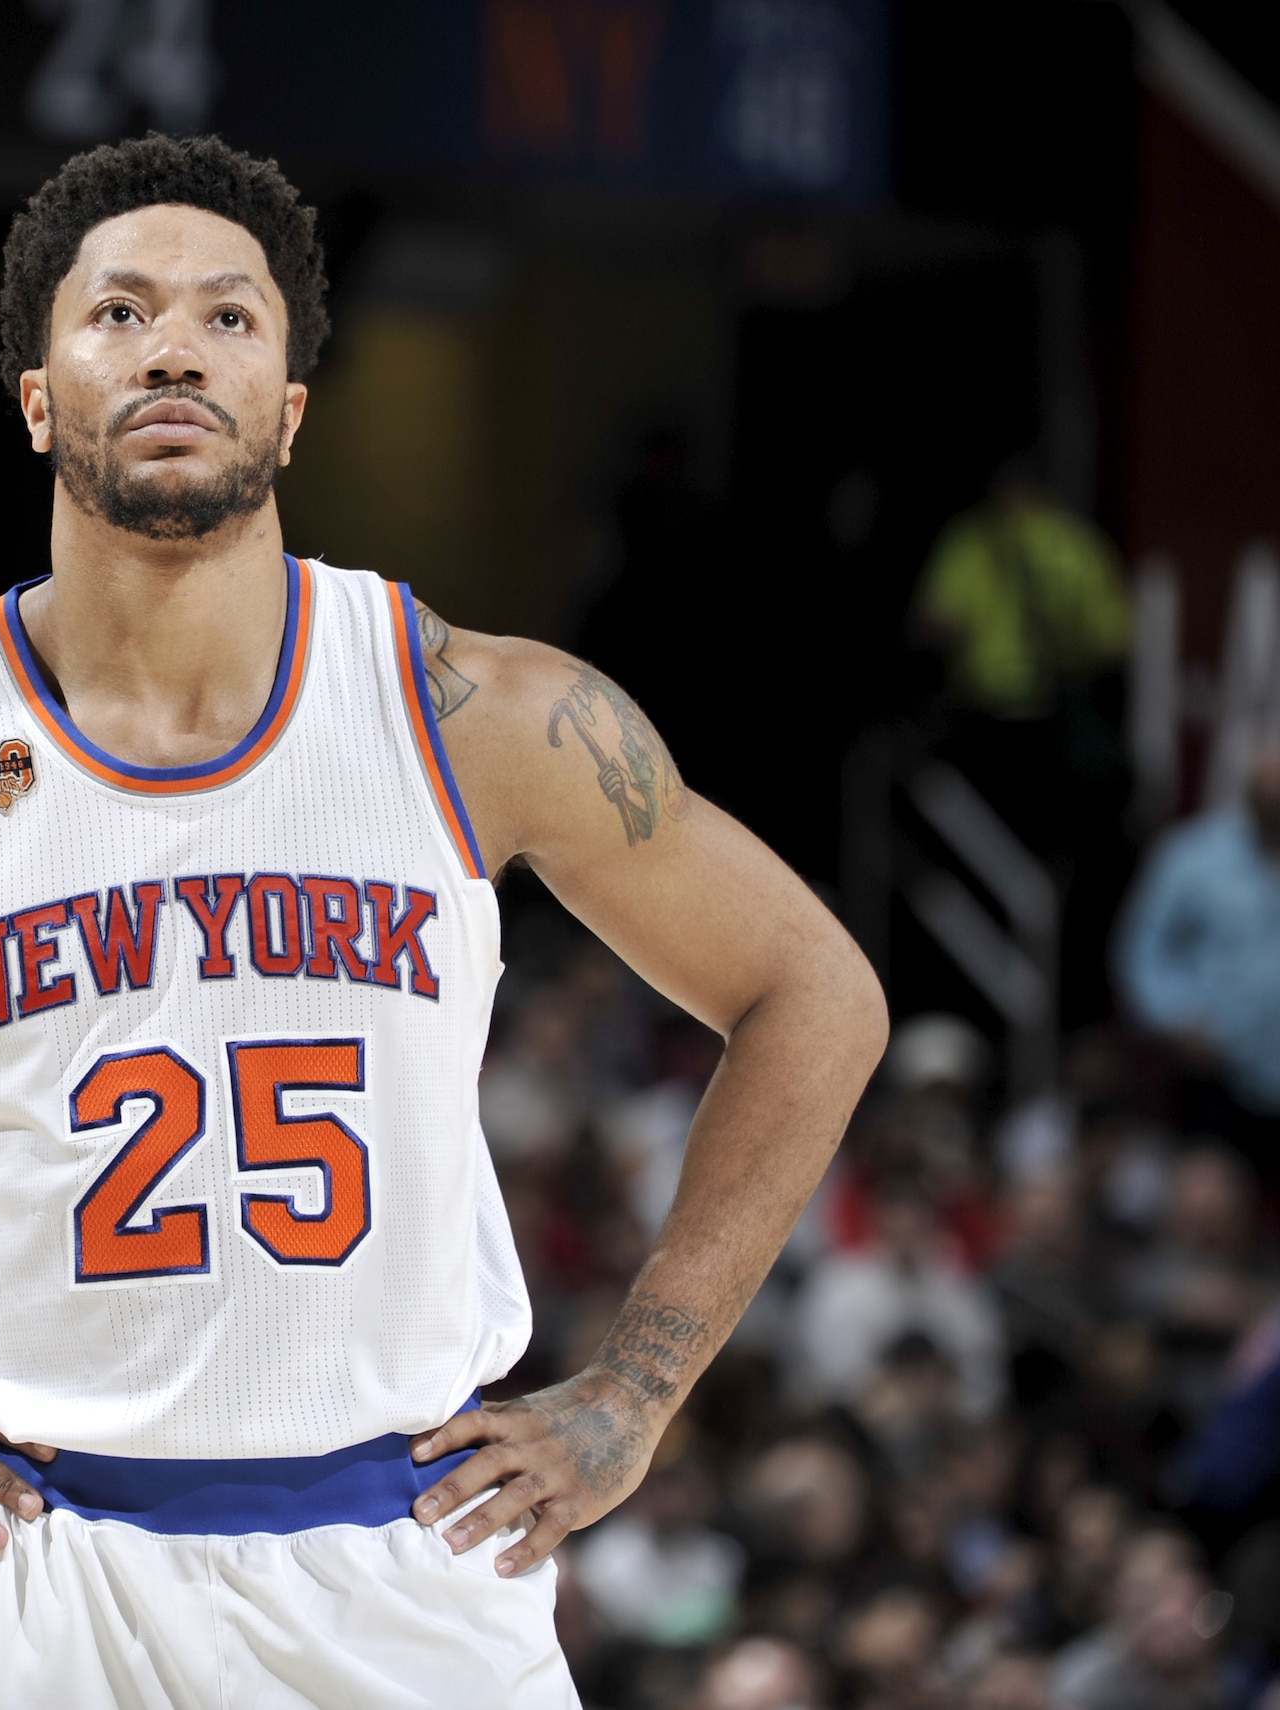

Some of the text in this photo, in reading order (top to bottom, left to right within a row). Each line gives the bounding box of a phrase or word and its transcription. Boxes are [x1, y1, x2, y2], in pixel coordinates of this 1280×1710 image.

[0, 760, 24, 771] 1946
[174, 872, 439, 1000] YORK
[69, 1037, 372, 1284] 25
